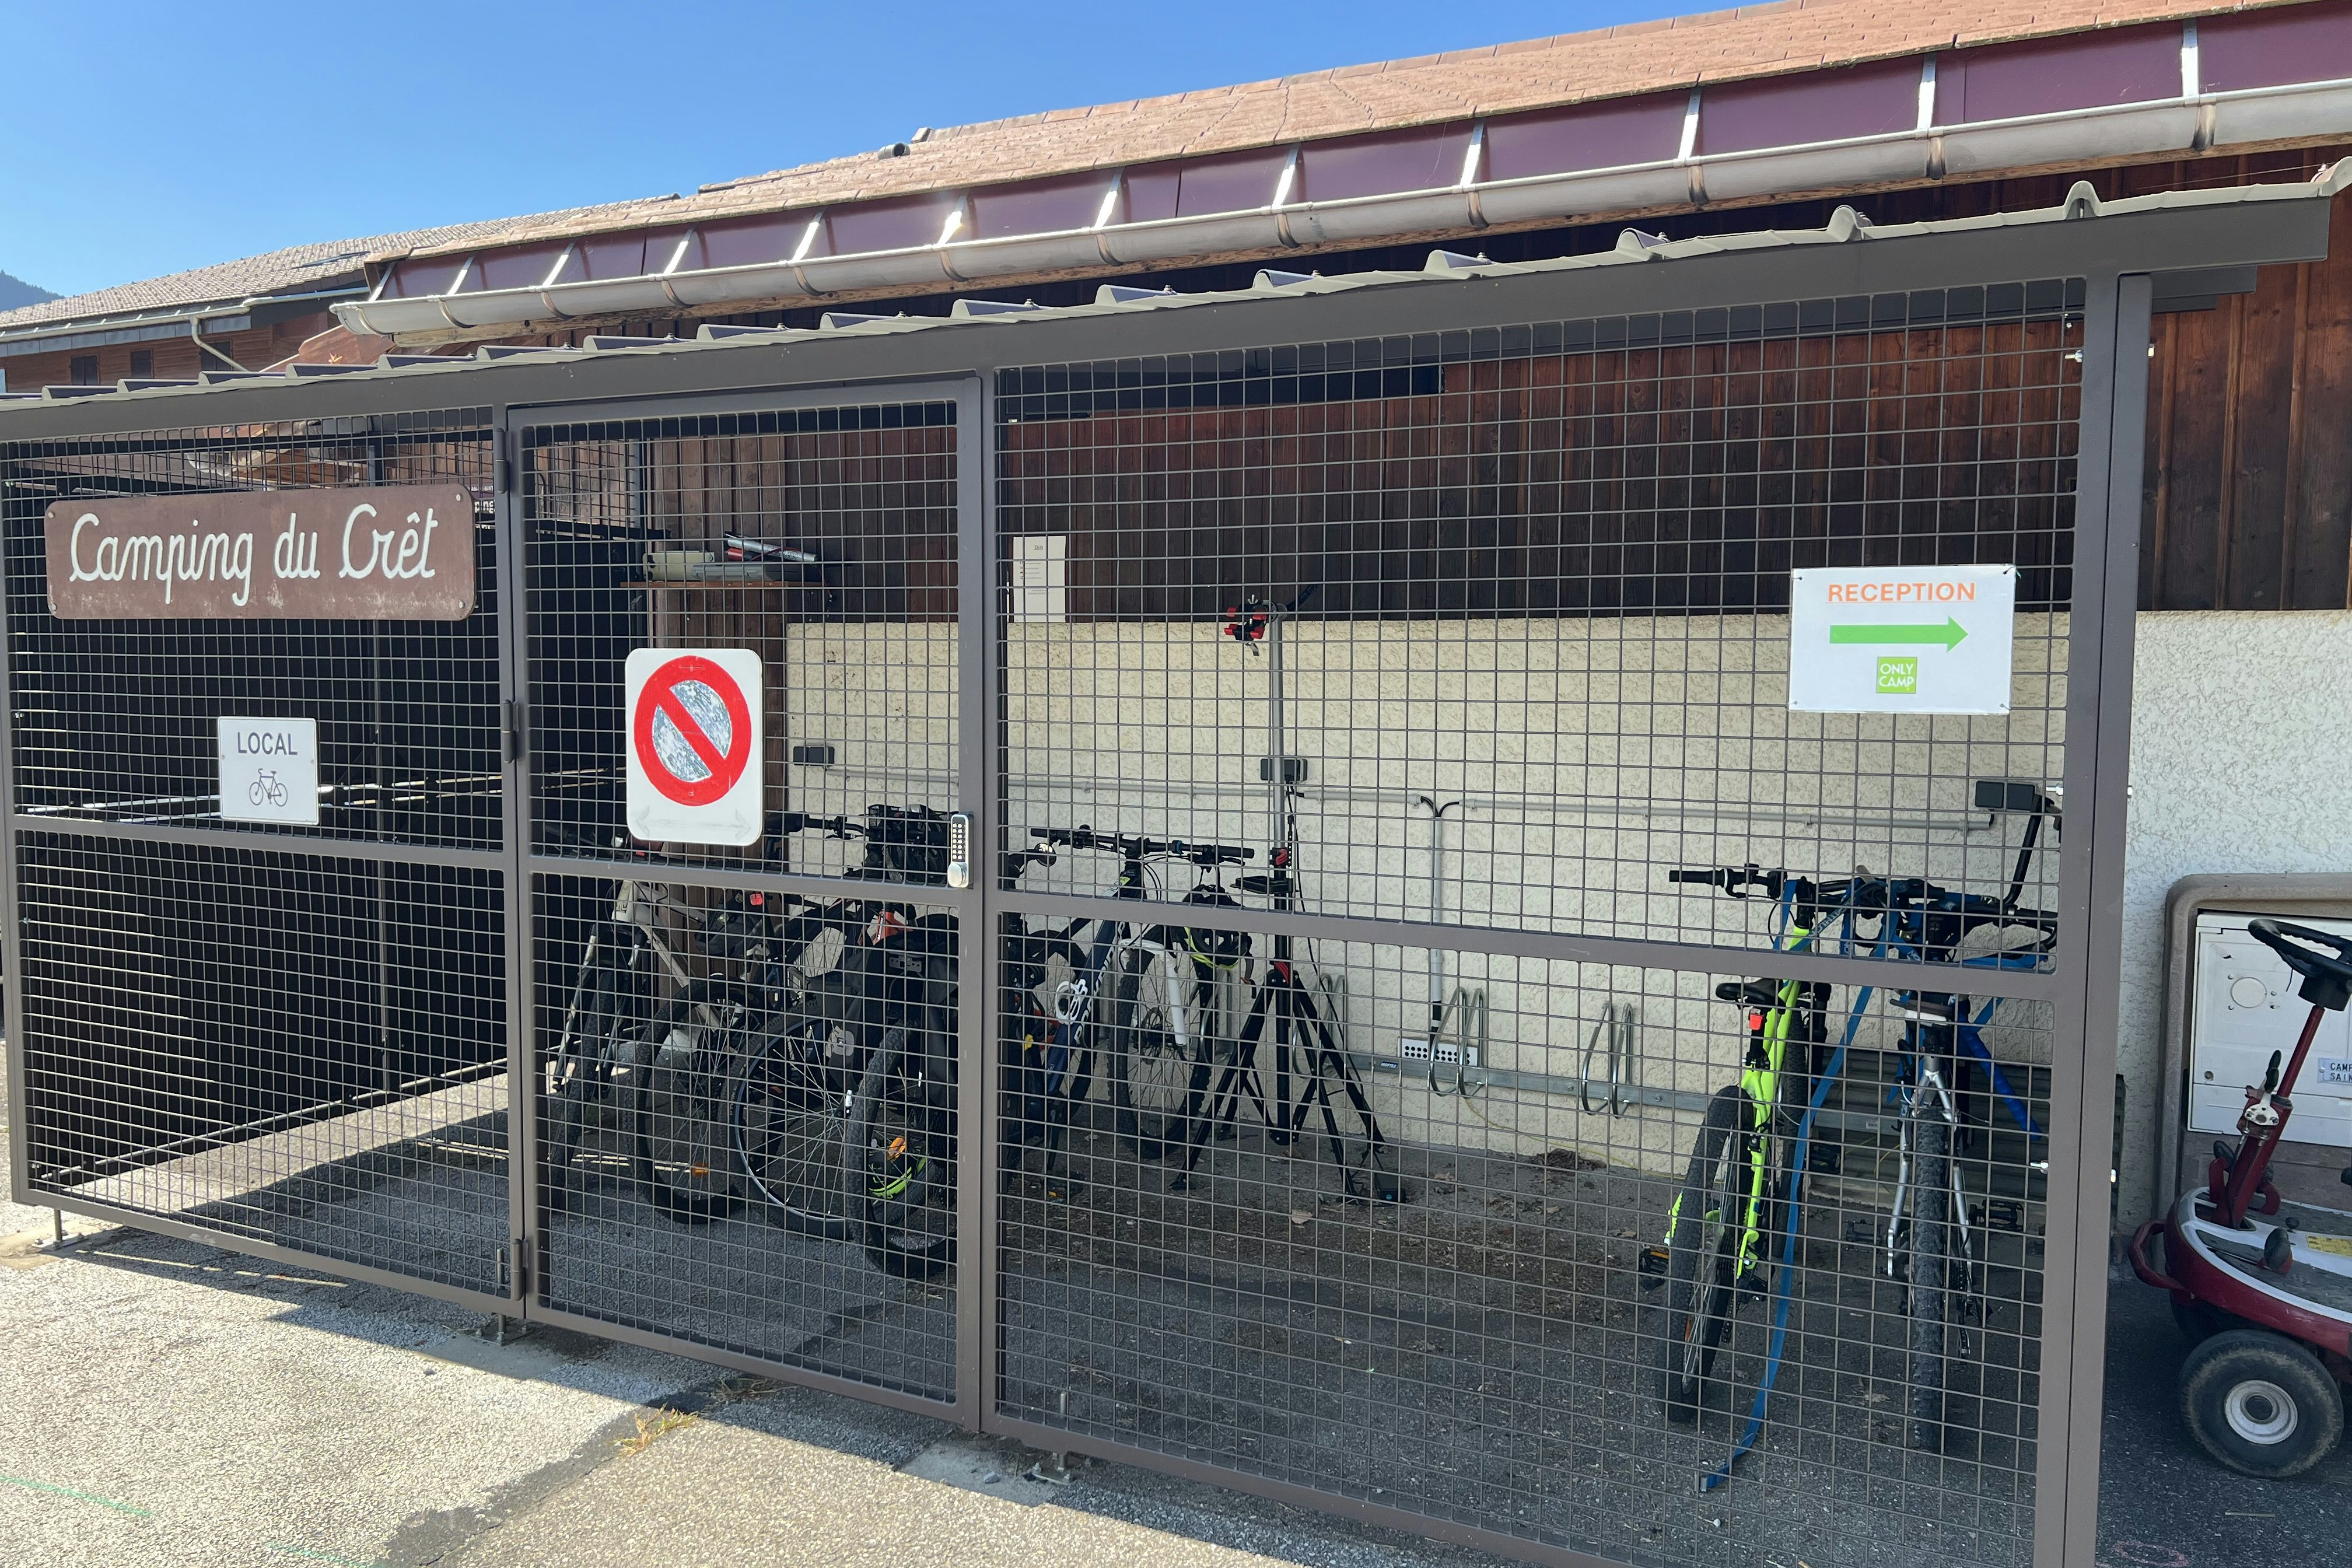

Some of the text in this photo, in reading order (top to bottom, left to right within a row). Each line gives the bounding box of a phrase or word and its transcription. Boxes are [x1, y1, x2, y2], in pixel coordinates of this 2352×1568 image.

[69, 503, 438, 607] Camping du Crêt
[1828, 582, 1976, 602] RECEPTION
[1880, 663, 1914, 675] ONLY
[1878, 676, 1915, 687] CAMP
[237, 732, 298, 755] LOCAL
